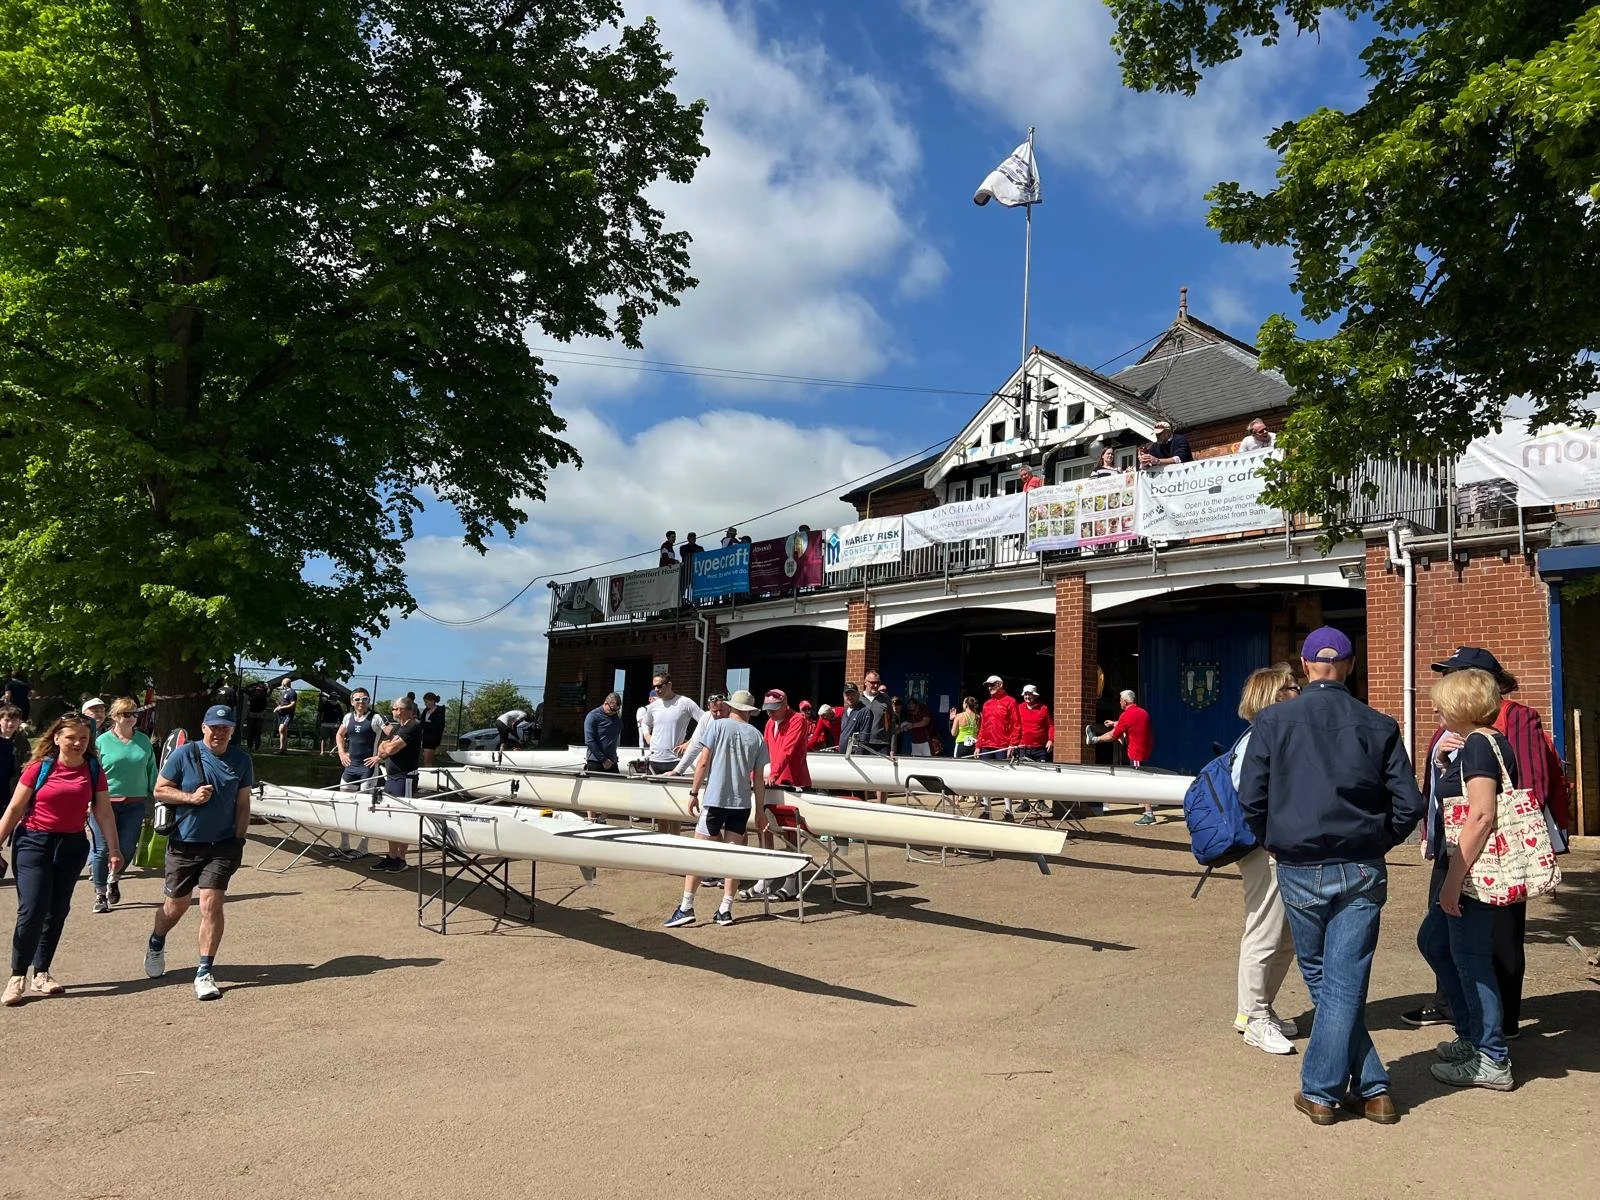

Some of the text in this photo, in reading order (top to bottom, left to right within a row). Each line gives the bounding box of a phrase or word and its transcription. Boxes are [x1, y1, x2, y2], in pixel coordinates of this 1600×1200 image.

[1151, 474, 1224, 495] boathouse
[932, 501, 992, 520] KINGHAMS
[1184, 502, 1202, 511] Open
[1203, 499, 1210, 507] to
[1211, 498, 1223, 506] the
[1223, 494, 1244, 506] public
[1171, 509, 1201, 521] Saturday
[1201, 507, 1207, 515] &
[1208, 504, 1233, 516] Sunday
[1175, 517, 1199, 528] Serving
[1199, 511, 1230, 524] breakfast
[1231, 510, 1248, 519] from
[947, 519, 965, 528] EVERY
[966, 515, 992, 526] TUESDAY
[877, 530, 900, 541] RISK
[844, 542, 900, 557] CONSULTANTS
[694, 547, 749, 576] typecraft
